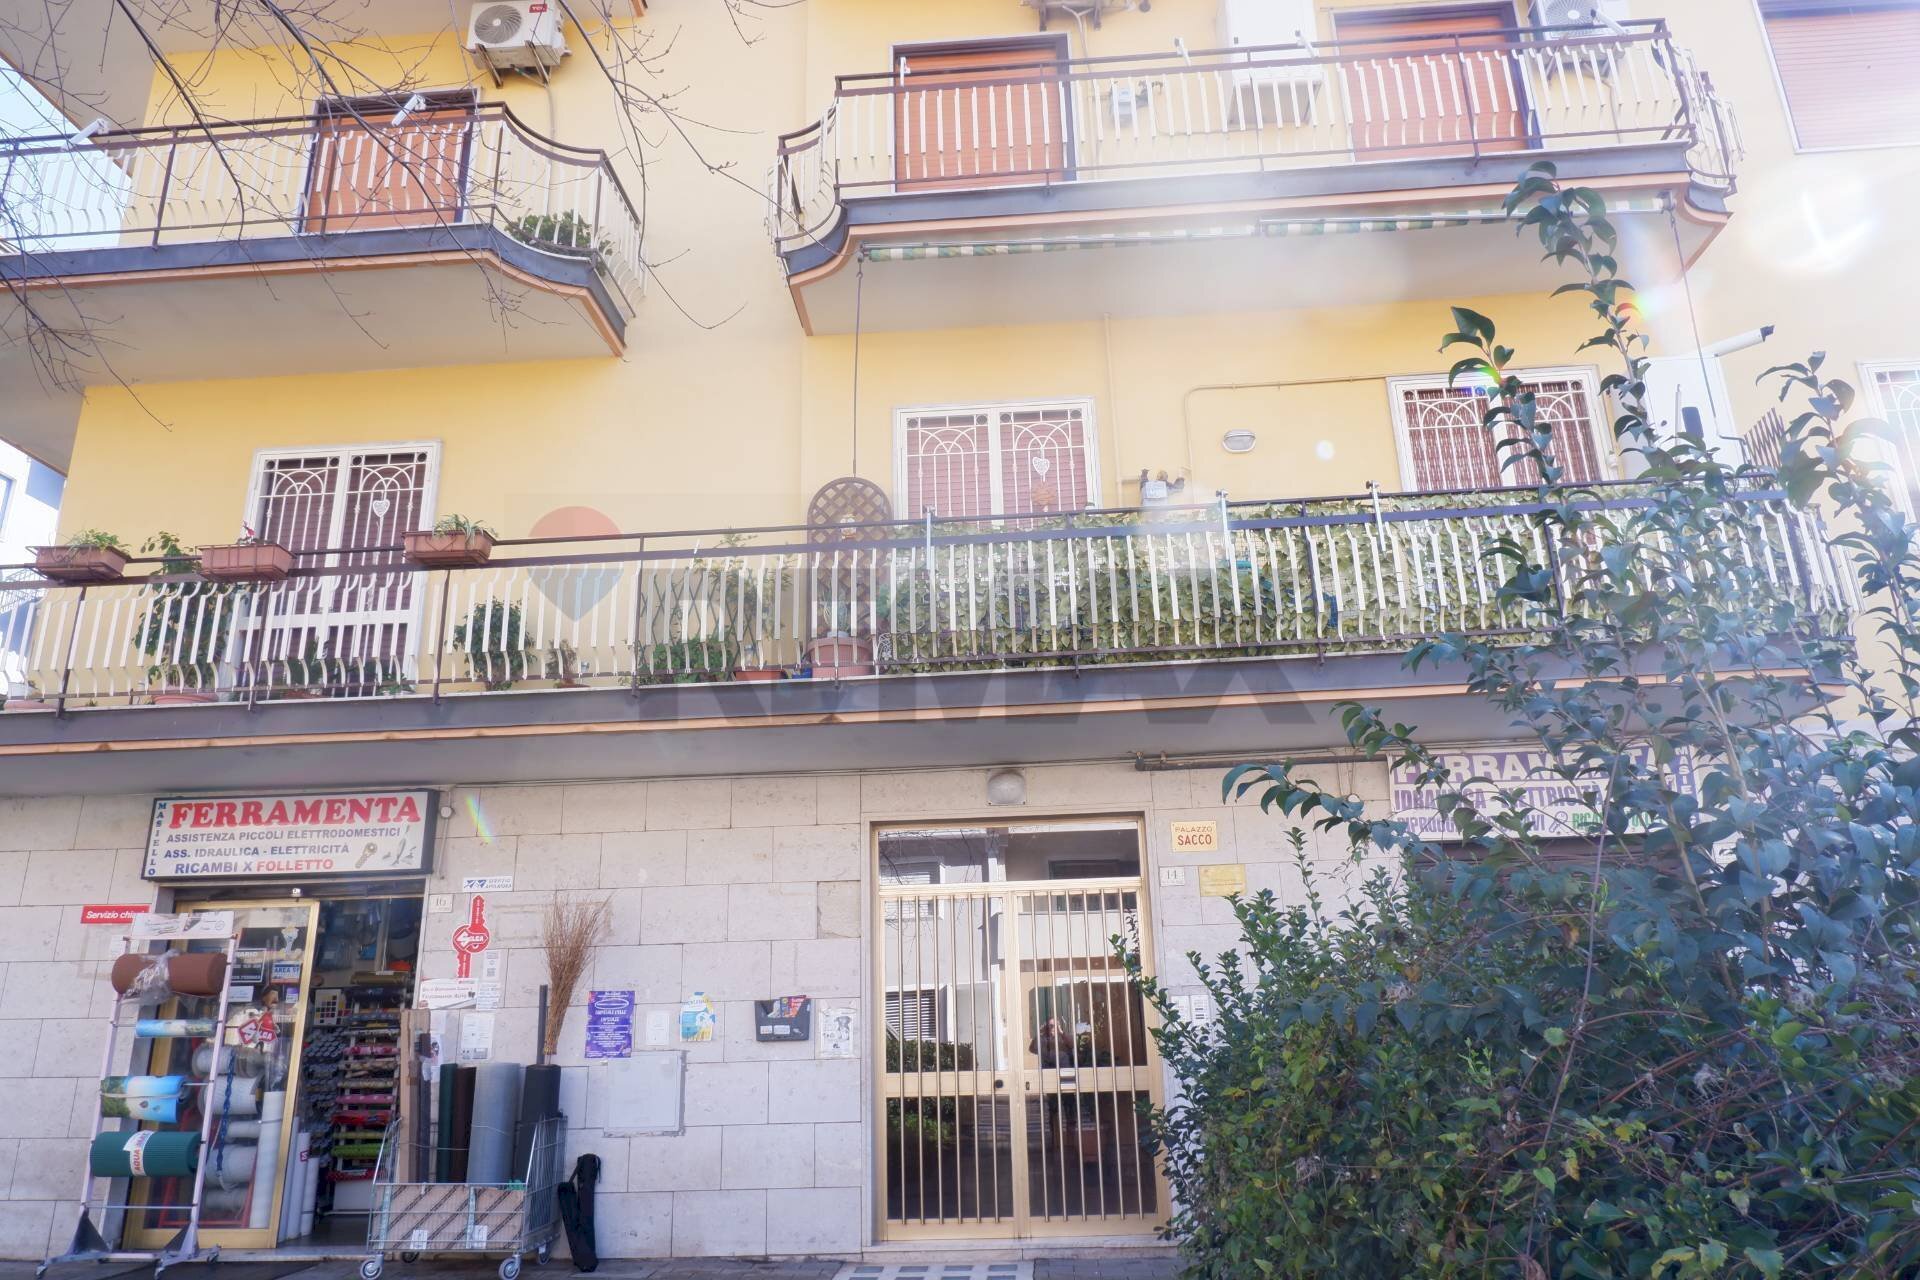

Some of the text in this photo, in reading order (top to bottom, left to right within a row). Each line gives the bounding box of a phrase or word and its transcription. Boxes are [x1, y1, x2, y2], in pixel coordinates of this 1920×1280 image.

[168, 796, 421, 829] FERRAMENTA
[148, 802, 167, 876] MASIELLO
[166, 827, 400, 843] ASSISTENZA PICCOLI ELETTRODOMESTICI
[1177, 833, 1212, 846] SACCO
[164, 848, 191, 859] ASS.
[194, 846, 260, 858] IDRAULICA
[174, 858, 334, 874] RICAMBI X FOLLETTO
[86, 910, 119, 919] Servizio
